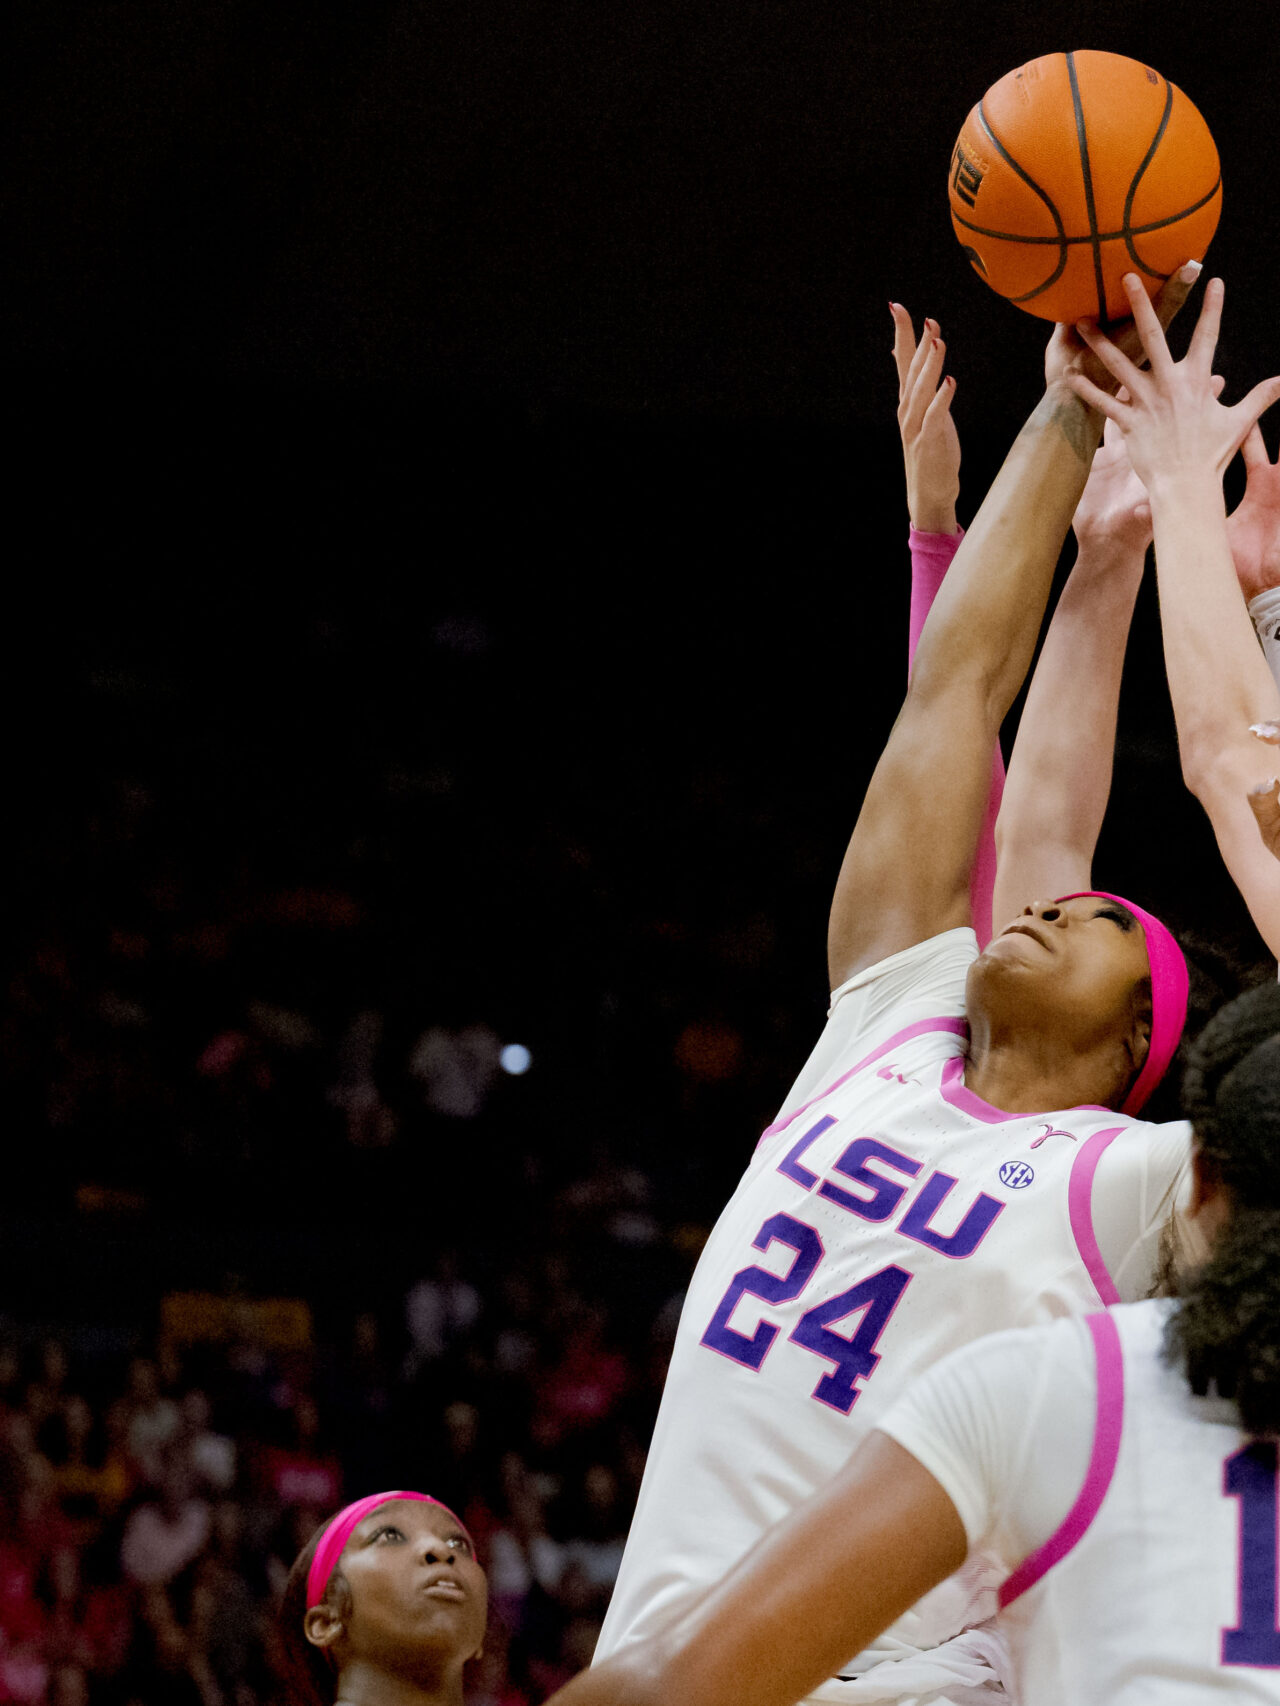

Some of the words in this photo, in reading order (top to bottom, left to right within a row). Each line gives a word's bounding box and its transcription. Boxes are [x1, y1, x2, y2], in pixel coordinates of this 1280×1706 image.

[776, 1114, 1006, 1259] LSU
[1000, 1161, 1034, 1189] SEC
[700, 1212, 914, 1416] 24
